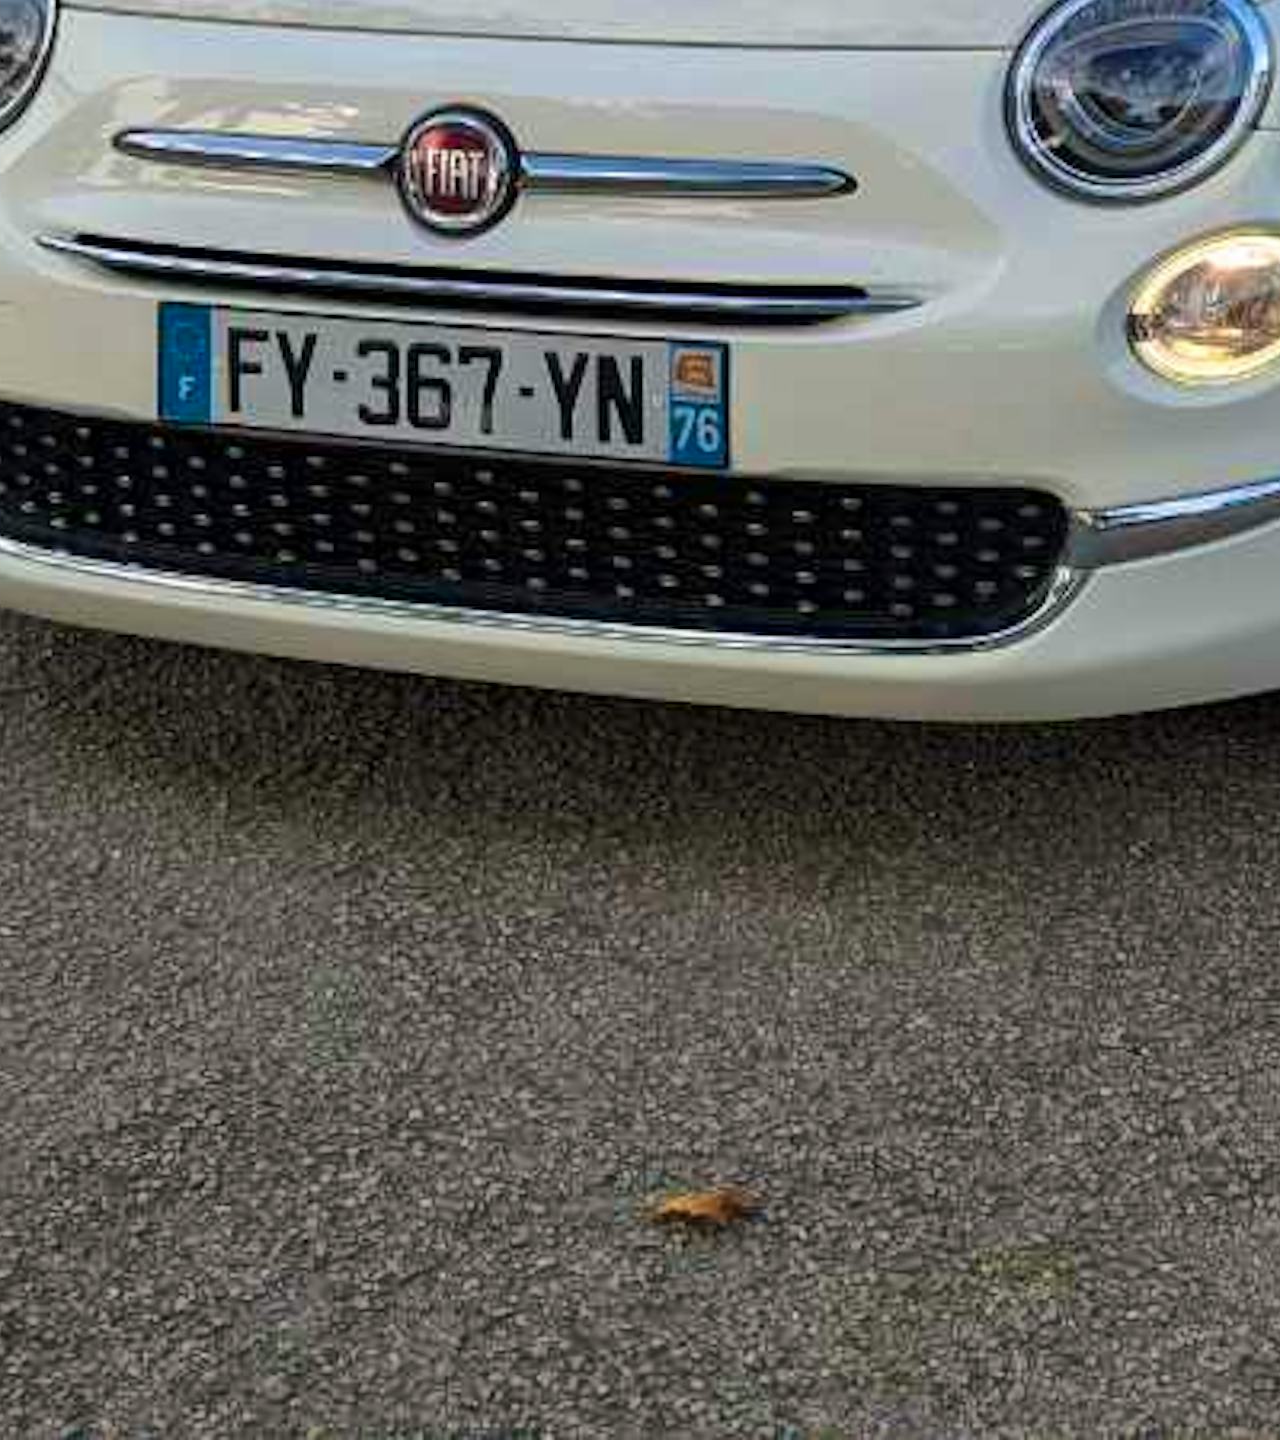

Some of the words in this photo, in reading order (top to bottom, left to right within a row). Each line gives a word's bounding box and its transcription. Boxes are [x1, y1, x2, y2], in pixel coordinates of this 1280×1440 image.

[424, 148, 485, 201] FIAT
[226, 327, 645, 446] FY-367-YN
[673, 405, 721, 454] 76
